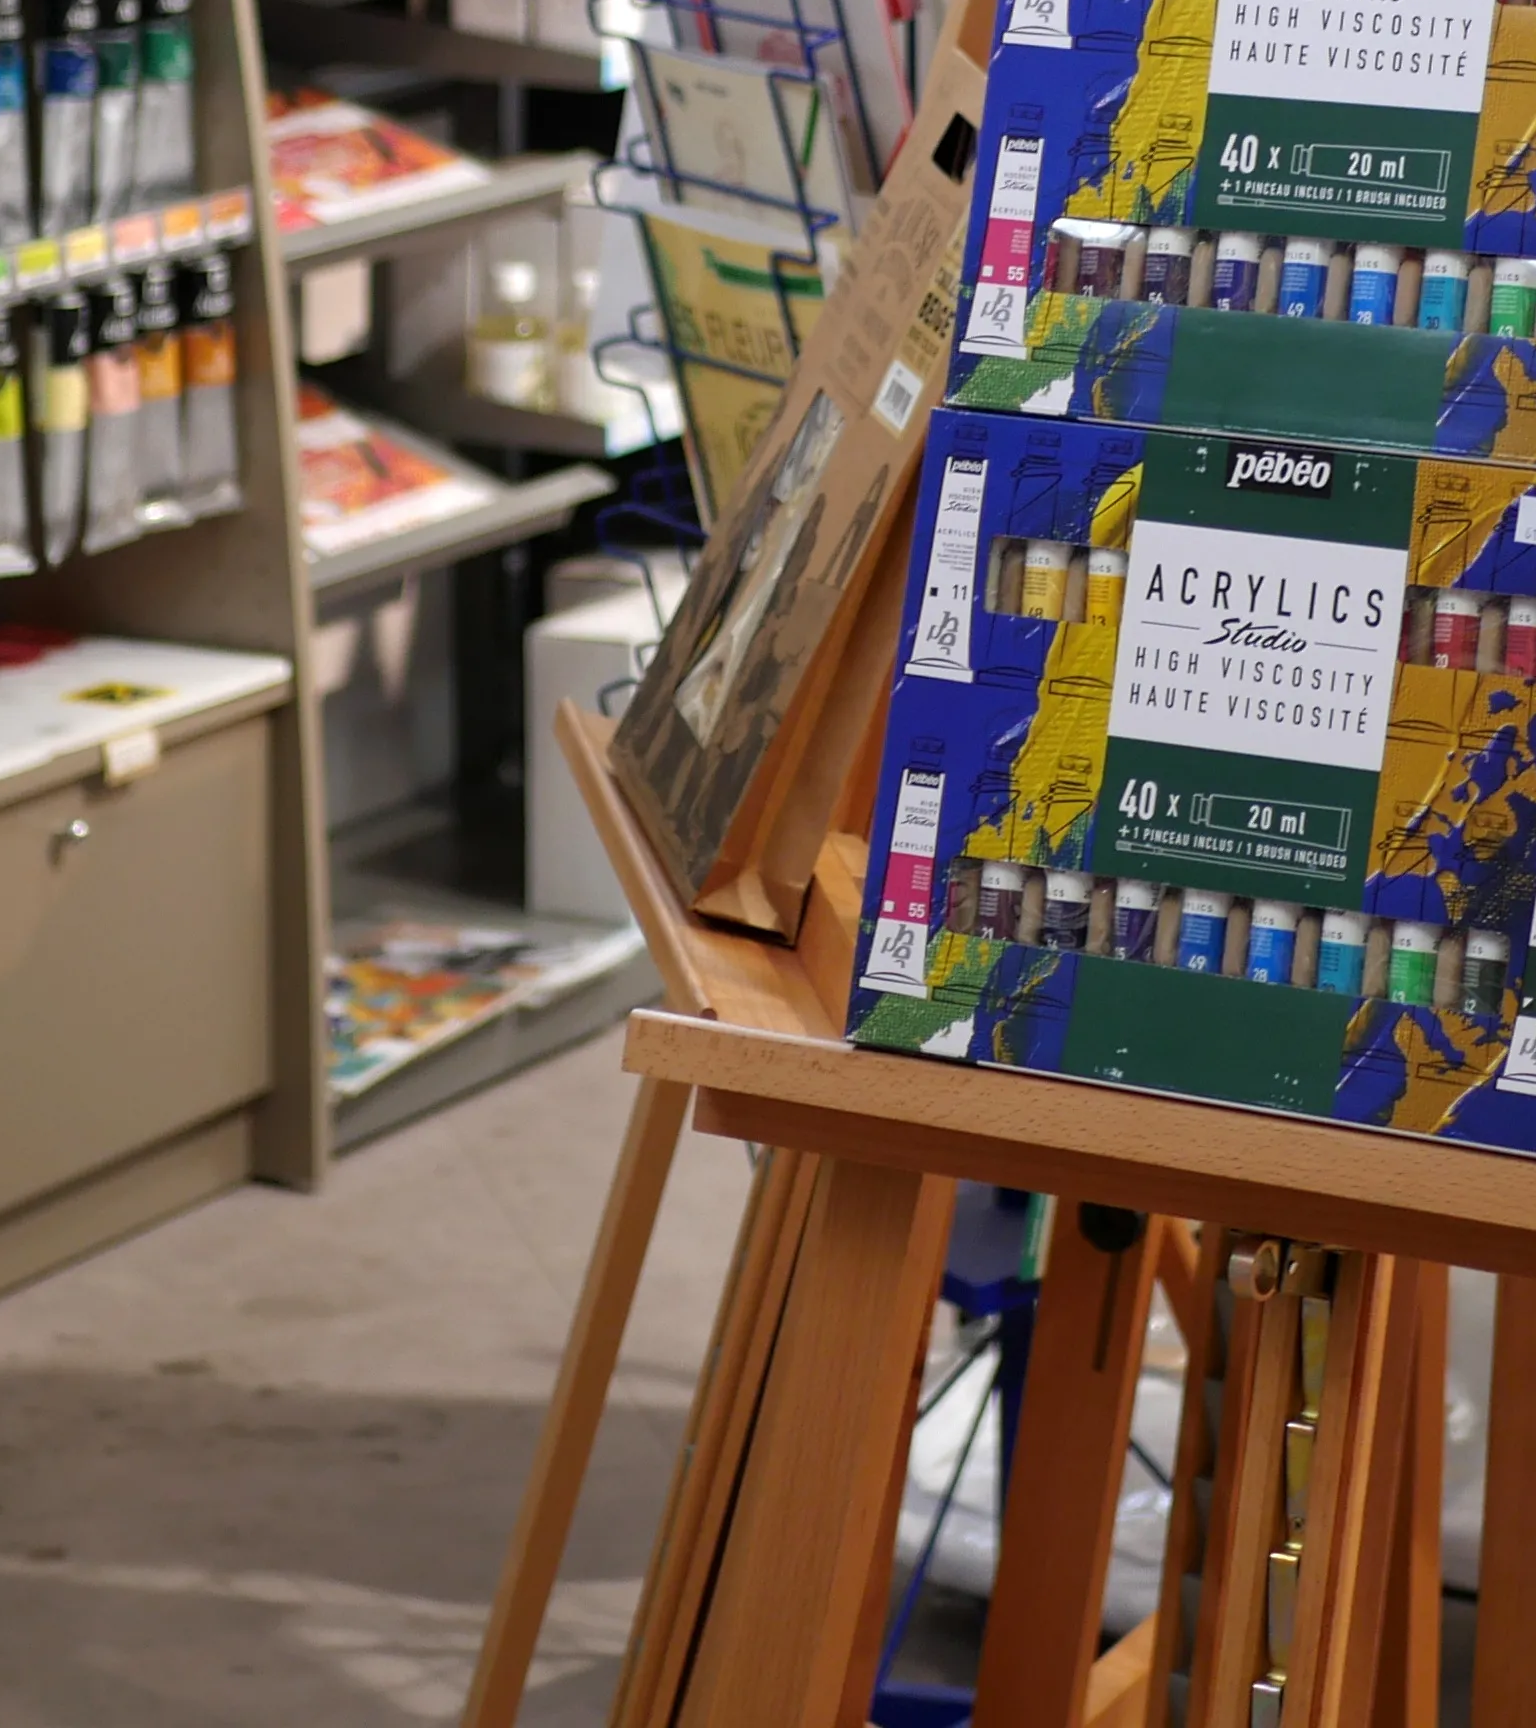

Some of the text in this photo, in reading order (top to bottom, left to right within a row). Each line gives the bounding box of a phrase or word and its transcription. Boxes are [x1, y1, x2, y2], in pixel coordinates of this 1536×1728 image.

[1235, 4, 1473, 41] HIGH VISCOSITY
[1229, 41, 1468, 77] HAUTE VISCOSITÉ
[1220, 134, 1259, 174] 40
[1348, 153, 1372, 176] 20
[1380, 156, 1404, 179] ml
[1235, 181, 1241, 194] 1
[1244, 181, 1290, 198] PINCEAU
[1293, 184, 1333, 200] INCLUS
[1347, 187, 1352, 202] 1
[1355, 188, 1389, 206] BRUSH
[1393, 187, 1447, 210] INCLUDED
[1007, 266, 1025, 281] 55
[1287, 302, 1304, 317] 49
[943, 501, 978, 513] Studio
[937, 528, 977, 538] ACRYLICS
[952, 585, 967, 600] 11
[1145, 564, 1385, 628] ACRYLICS
[1203, 618, 1308, 653] Studio
[1135, 646, 1373, 697] HIGH VISCOSITY
[1129, 683, 1368, 734] HAUTE VISCOSITÉ
[1118, 779, 1158, 820] 40
[1248, 805, 1273, 830] 20
[1281, 810, 1305, 836] ml
[1143, 828, 1190, 846] PINCEAU
[1193, 833, 1233, 851] INCLUS
[1256, 843, 1291, 864] BRUSH
[1295, 848, 1346, 869] INCLUDED
[908, 903, 926, 918] 55
[1188, 954, 1206, 970] 49
